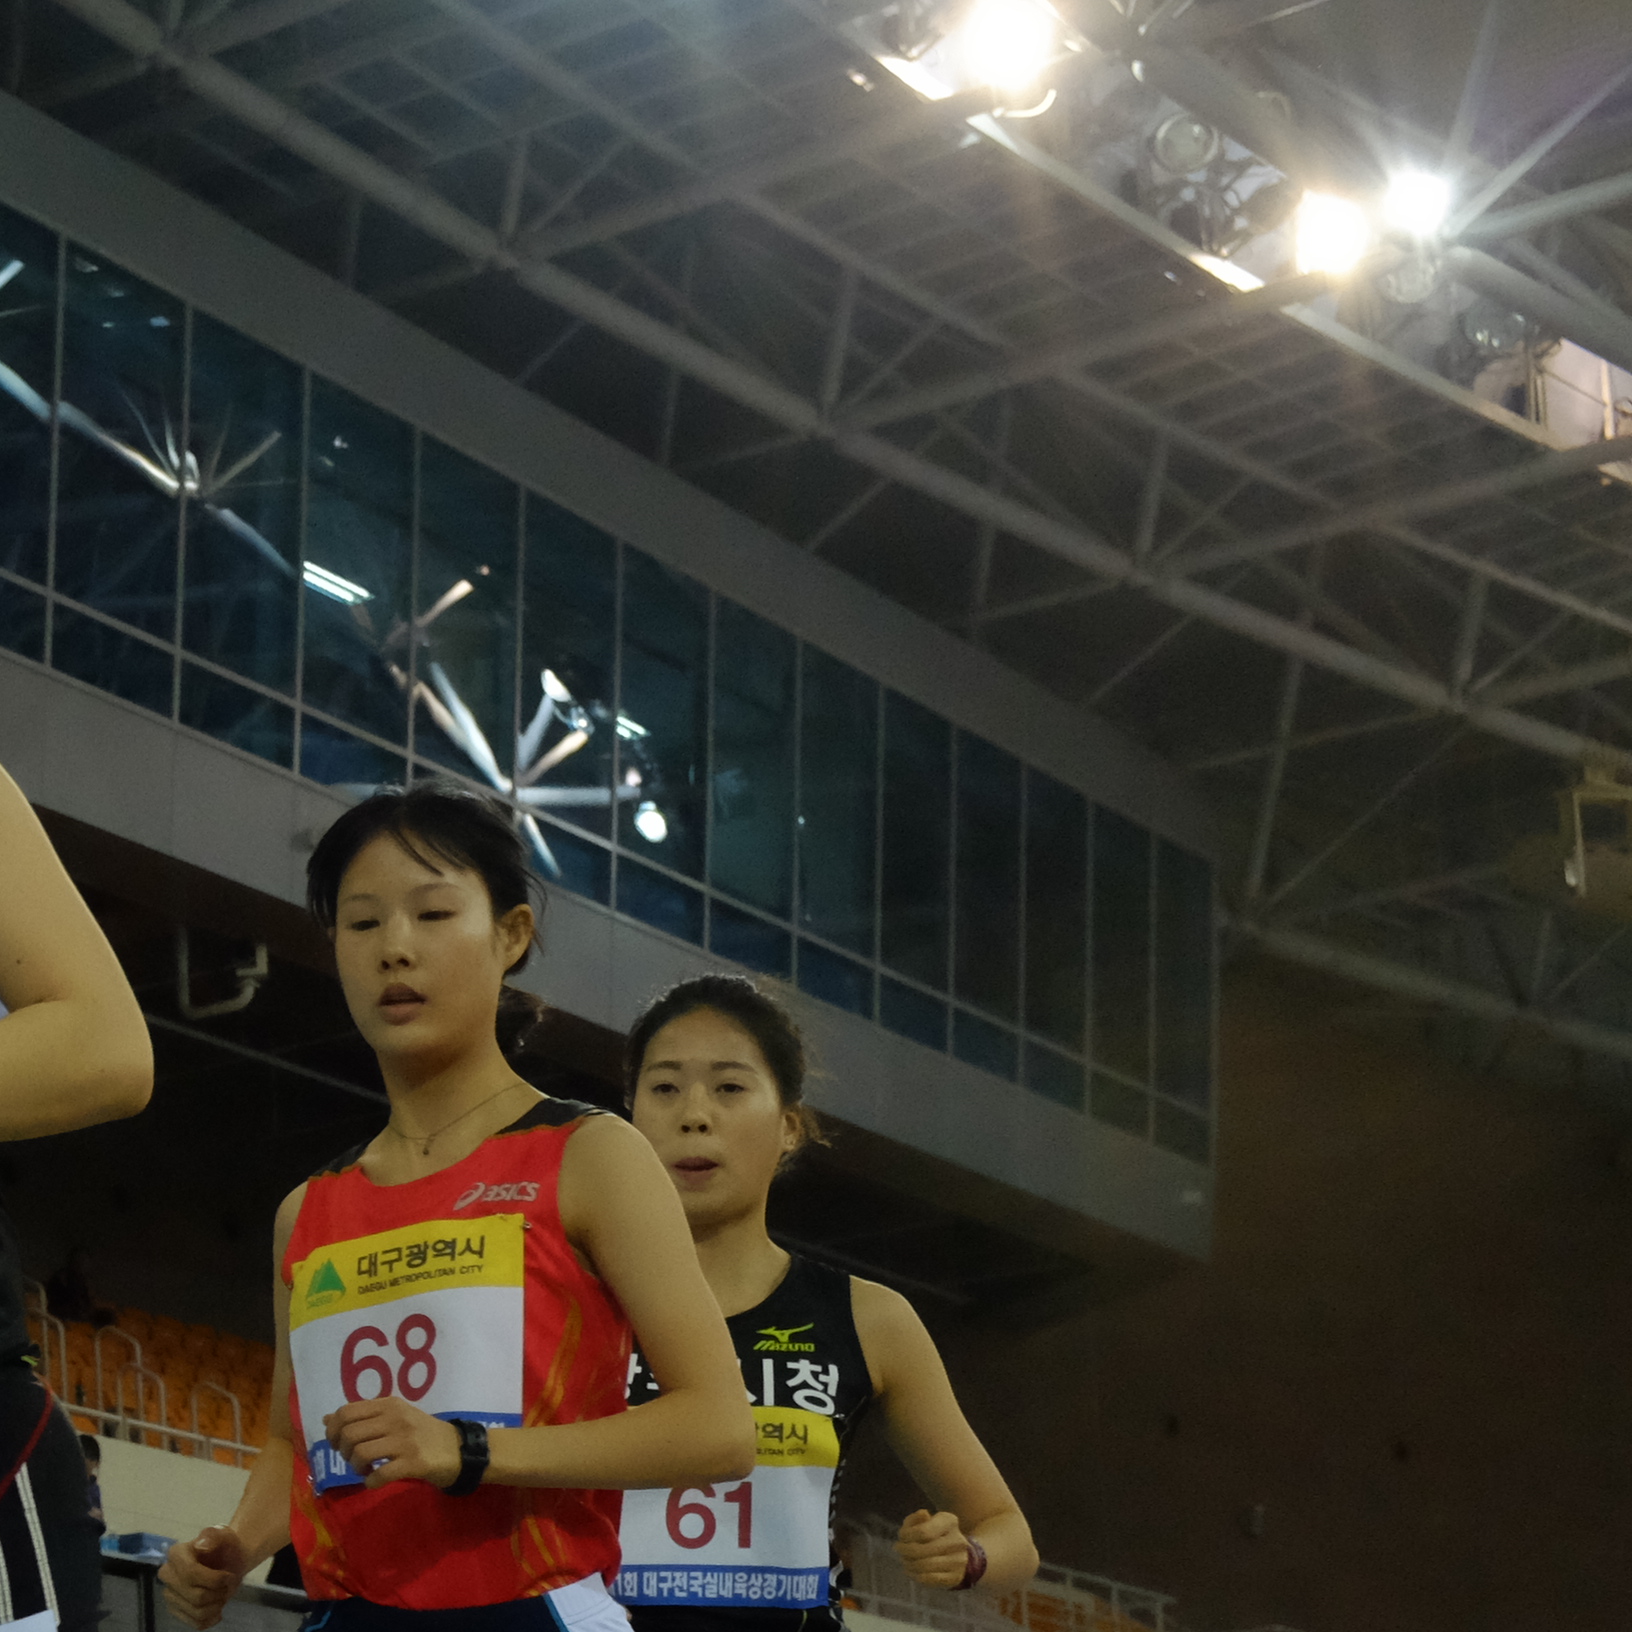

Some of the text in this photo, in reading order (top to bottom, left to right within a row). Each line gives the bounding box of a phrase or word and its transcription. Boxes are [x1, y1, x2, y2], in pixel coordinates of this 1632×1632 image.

[356, 1234, 486, 1279] 대구광역시
[357, 1264, 484, 1295] DAEGU METROPOLITAN CITY
[340, 1313, 437, 1402] 68
[755, 1421, 809, 1445] 역시
[665, 1480, 753, 1549] 61
[609, 1571, 820, 1601] 1회 대구전국실내육상경기대회
